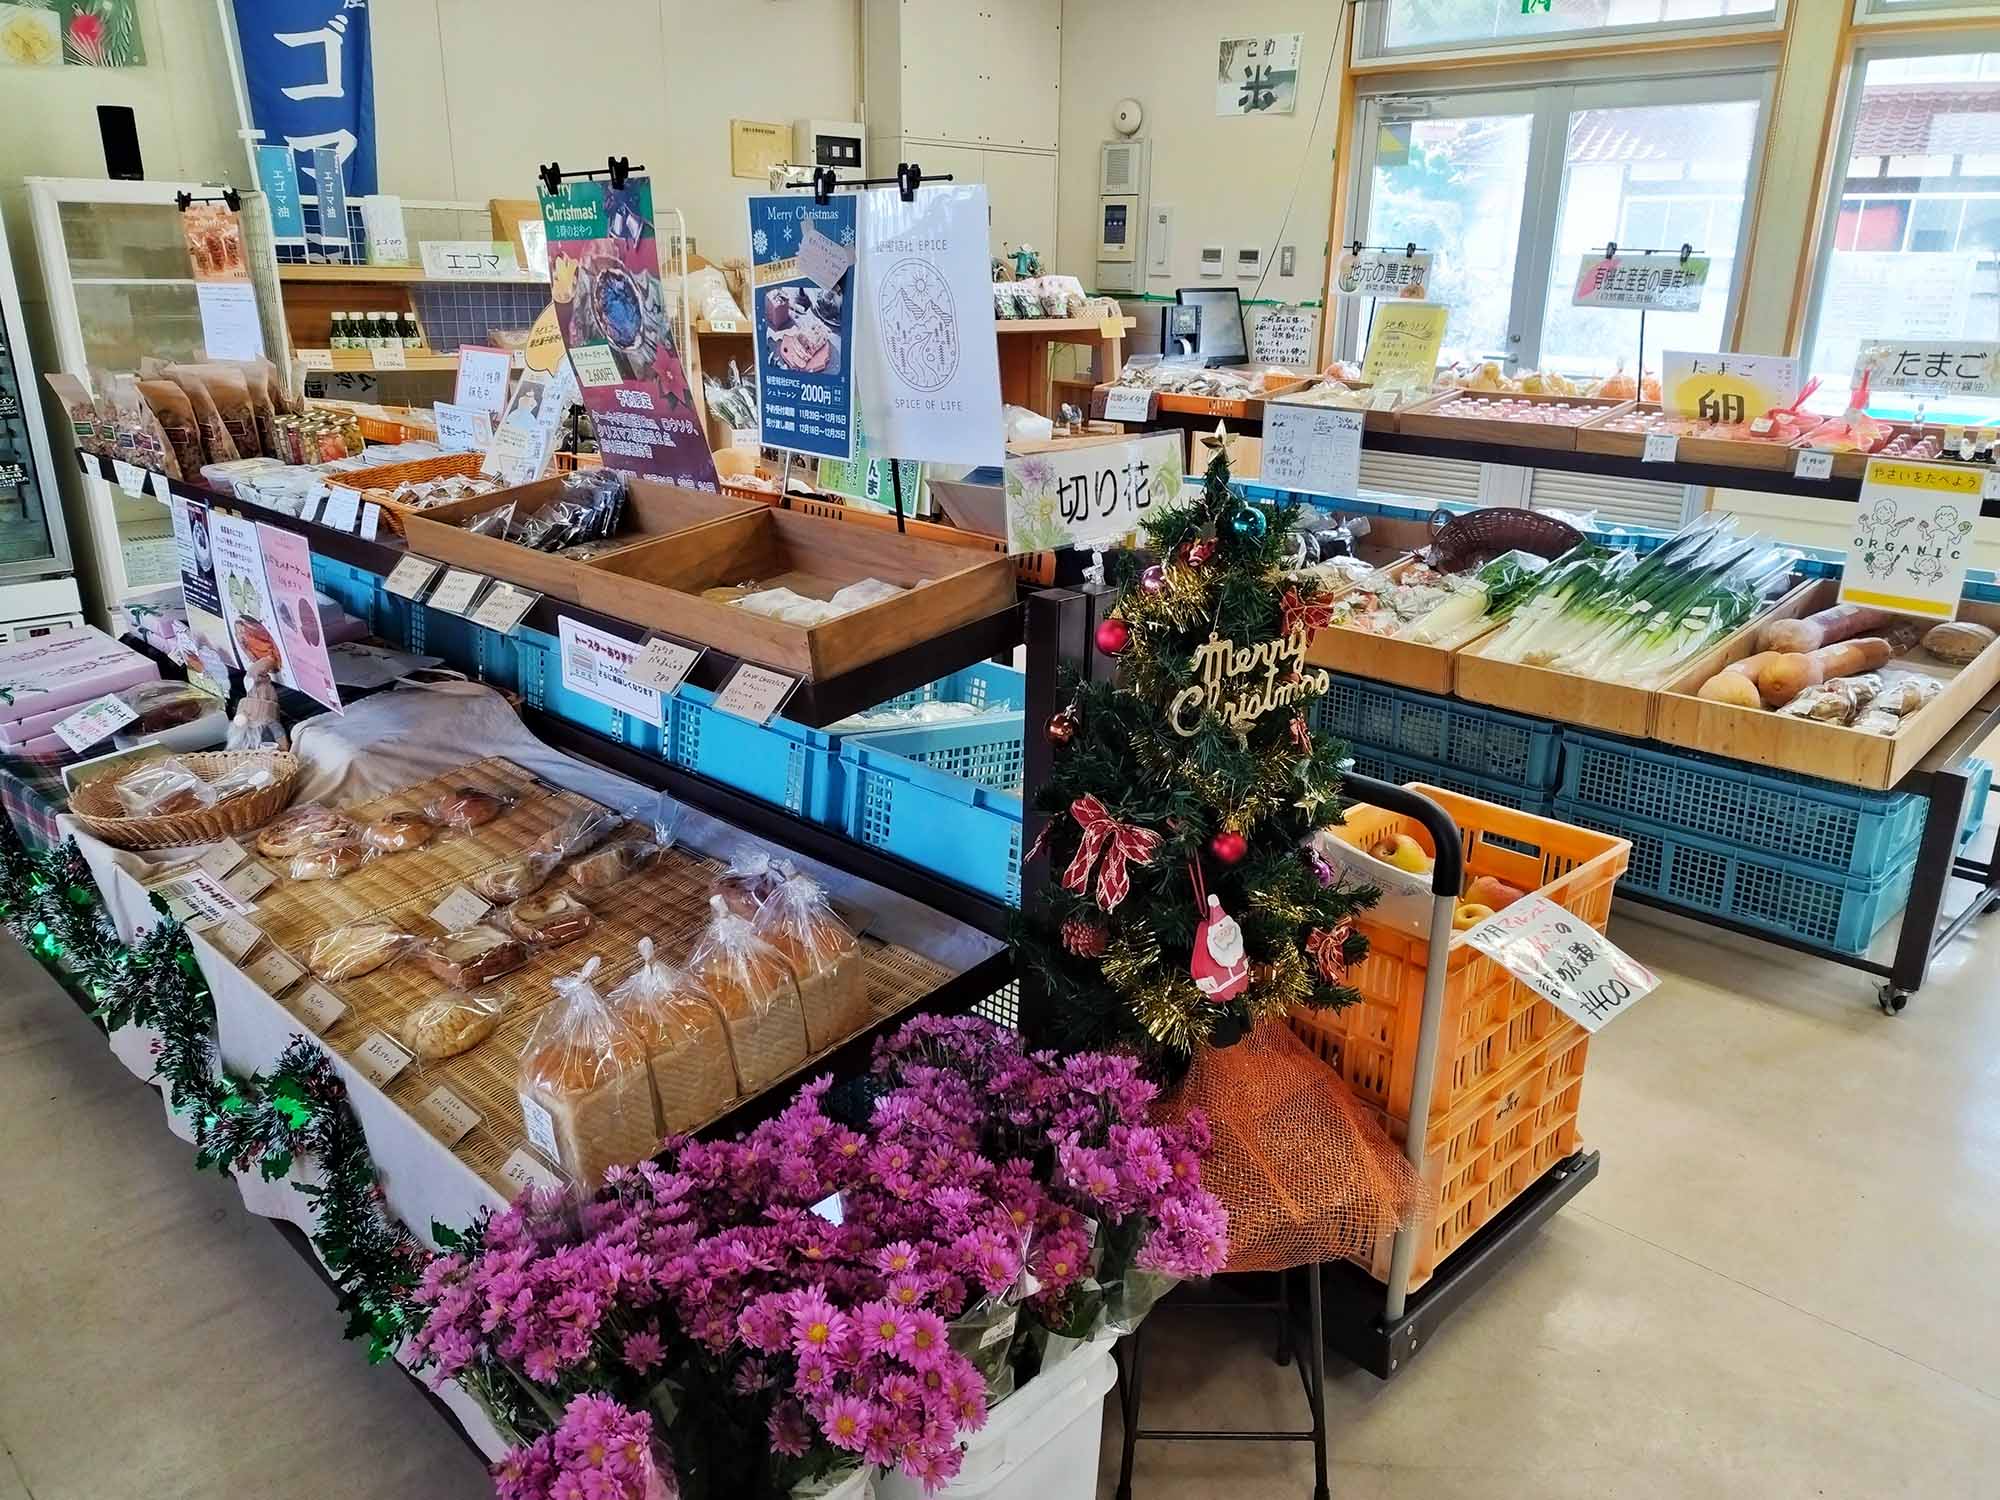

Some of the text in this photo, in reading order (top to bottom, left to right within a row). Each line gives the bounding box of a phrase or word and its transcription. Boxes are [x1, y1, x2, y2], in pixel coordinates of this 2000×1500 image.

[1247, 38, 1276, 57] こめ
[1239, 64, 1278, 113] 米
[272, 169, 290, 219] エゴマ油
[545, 201, 598, 223] Christmas!
[767, 206, 840, 221] Merry Christmas
[918, 239, 948, 251] EPICE
[446, 252, 500, 270] エゴマ
[1348, 261, 1425, 286] 地元の農産物
[1692, 360, 1756, 376] たまご
[1893, 350, 1988, 378] たまご
[585, 367, 616, 385] 2,600円
[800, 383, 832, 405] 2000円
[895, 398, 964, 411] SPICE OF LIFE
[1698, 389, 1744, 425] 卵
[1056, 461, 1151, 524] 切り花
[1853, 537, 1961, 560] ORGANIC
[1191, 628, 1306, 683] Merry
[1168, 668, 1330, 737] Christmas
